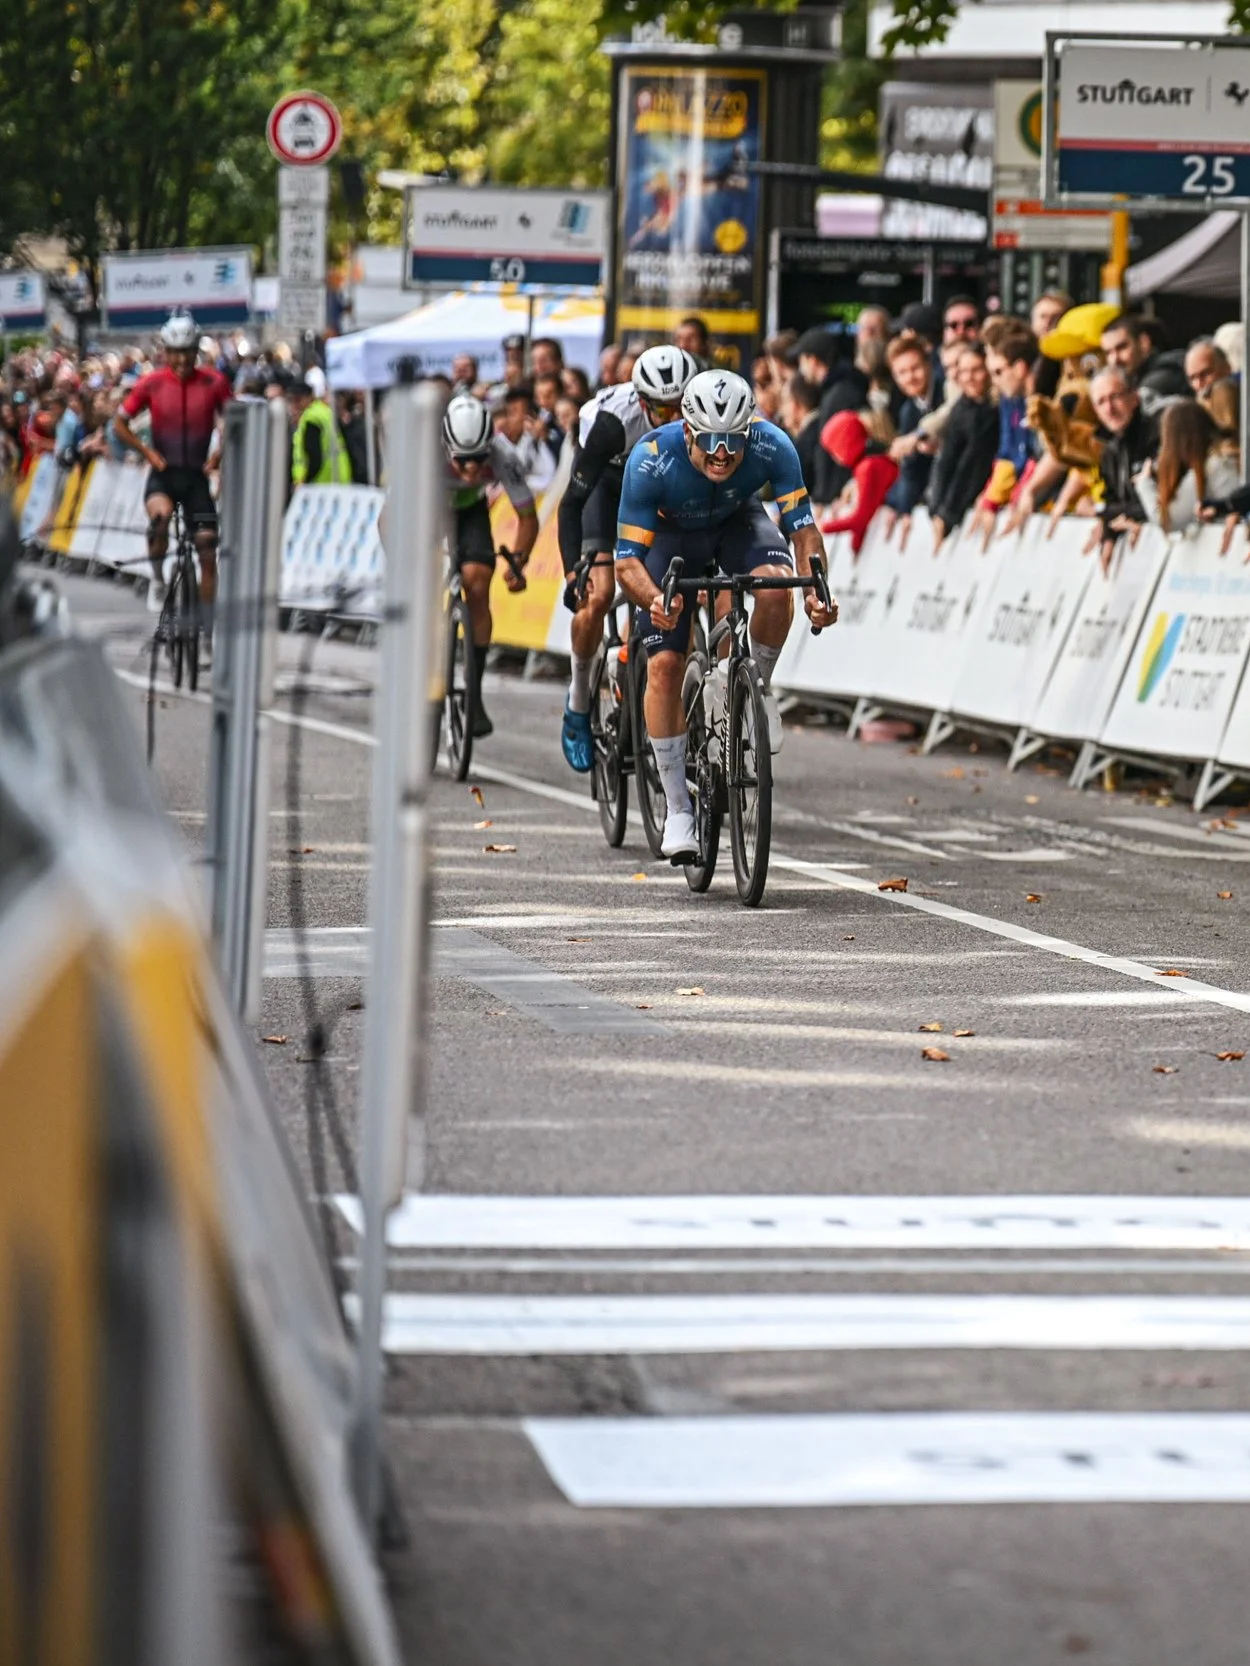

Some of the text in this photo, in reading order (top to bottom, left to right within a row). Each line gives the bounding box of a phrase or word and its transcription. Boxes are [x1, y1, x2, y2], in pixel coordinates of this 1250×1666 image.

[1077, 79, 1194, 105] STUTTGART
[1182, 155, 1235, 194] 25
[490, 257, 526, 281] 50
